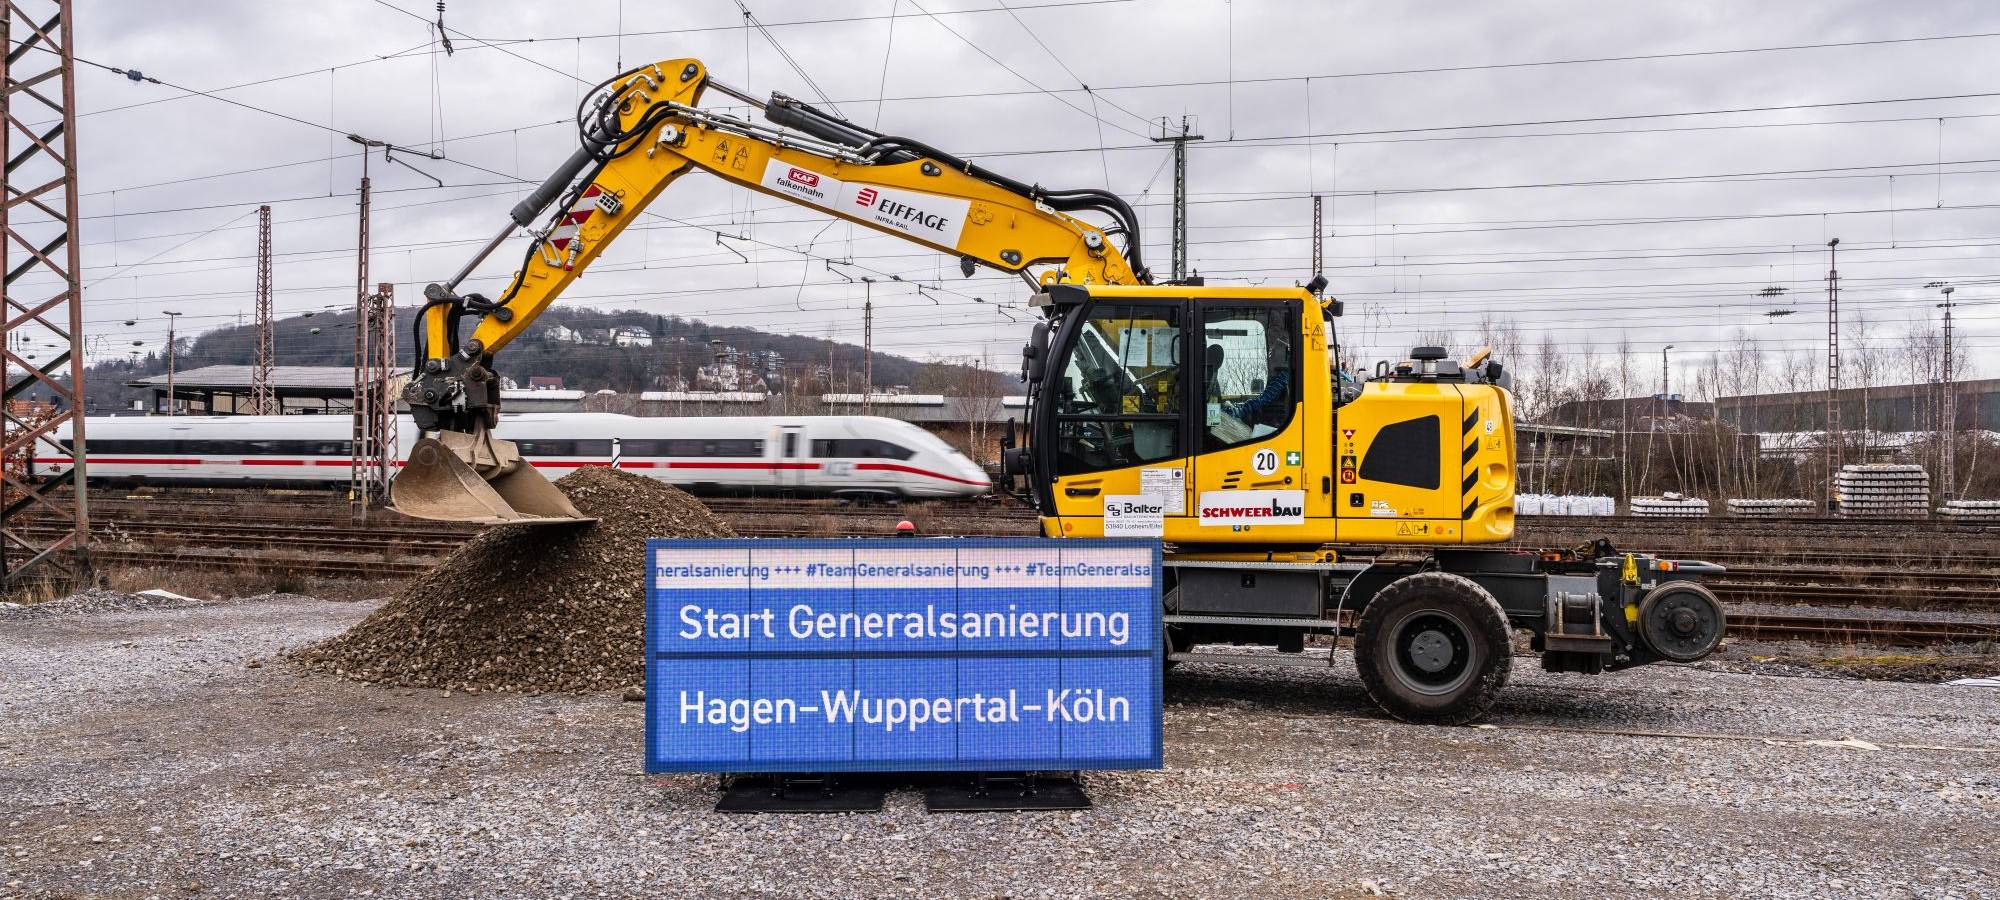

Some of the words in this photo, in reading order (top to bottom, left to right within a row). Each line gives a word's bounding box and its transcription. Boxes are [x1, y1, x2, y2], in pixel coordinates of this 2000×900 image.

[792, 171, 815, 184] KAF
[776, 177, 824, 199] falkenhahn
[878, 198, 949, 232] EIFFAGE
[1257, 453, 1275, 471] 20
[1123, 502, 1163, 514] Balter
[806, 563, 989, 580] #TeamGeneralsanierung
[1026, 562, 1150, 577] #TeamGeneralsa
[679, 604, 775, 639] Start
[788, 604, 1130, 646] Generalsanierung
